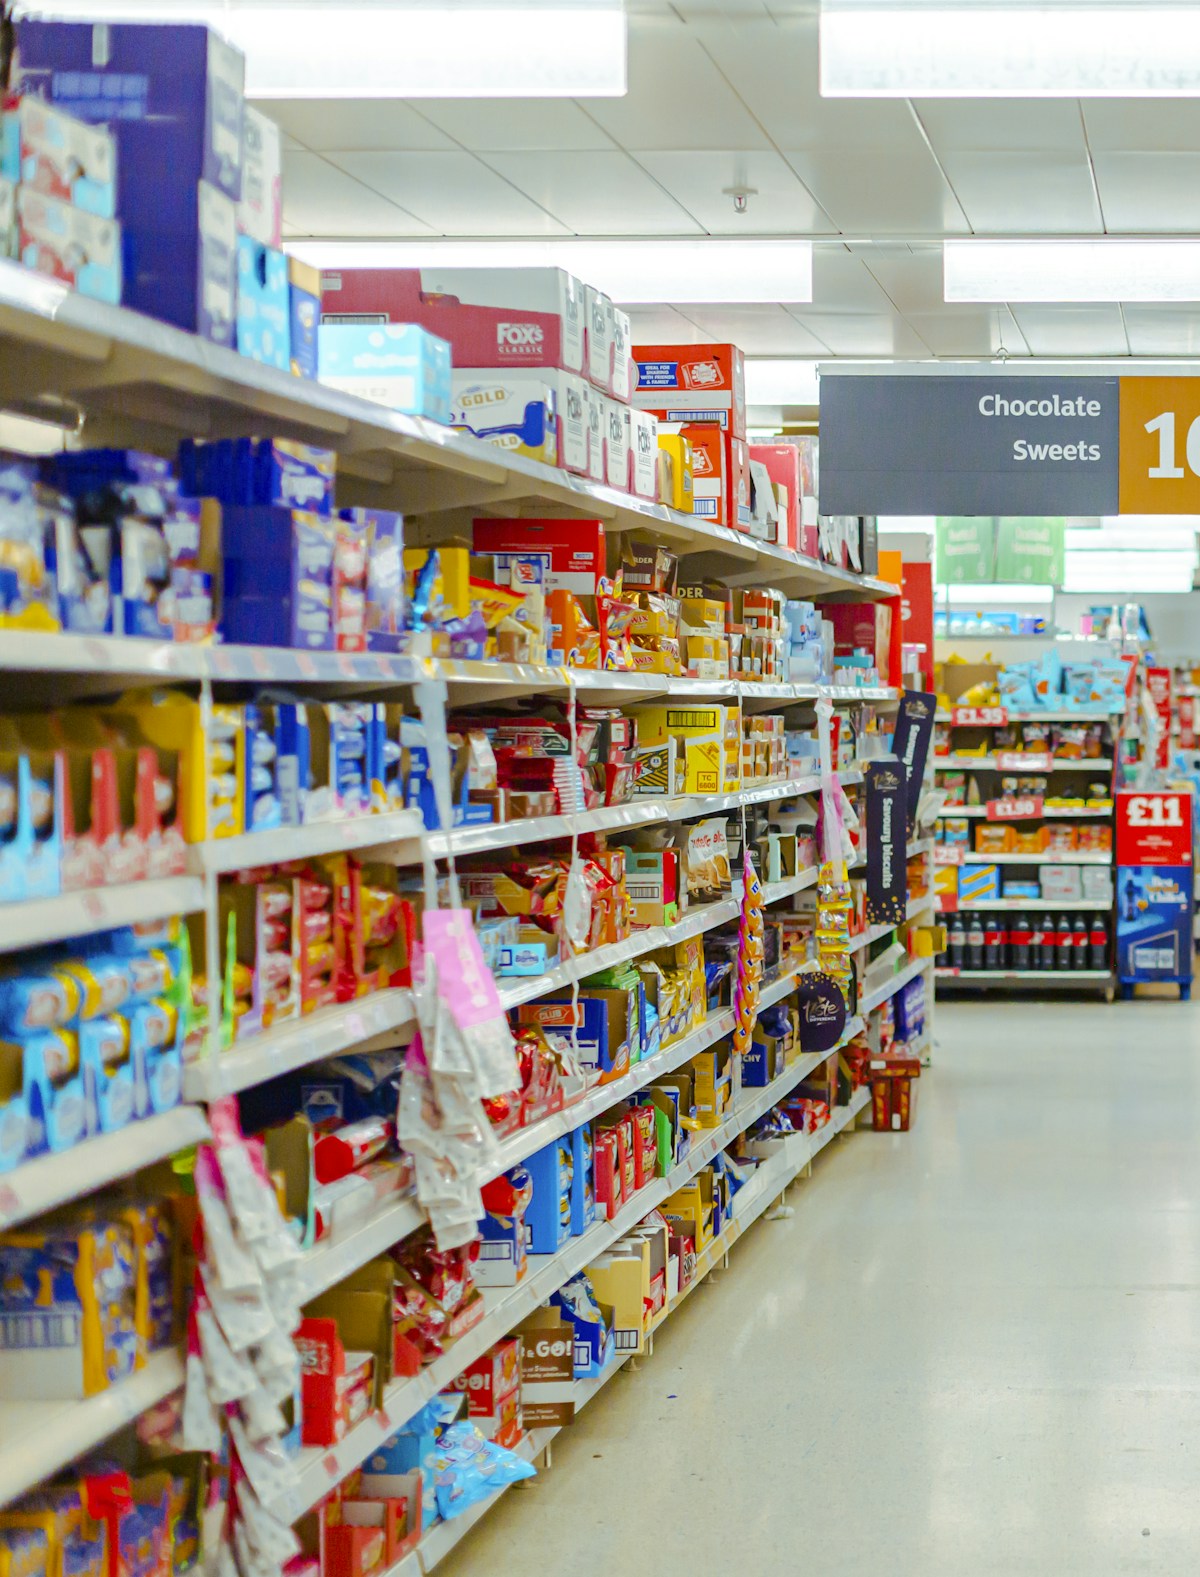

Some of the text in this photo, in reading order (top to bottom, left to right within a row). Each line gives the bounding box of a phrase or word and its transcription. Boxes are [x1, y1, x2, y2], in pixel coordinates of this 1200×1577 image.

[461, 389, 505, 407] GOLD
[979, 394, 1101, 417] Chocolate
[1013, 440, 1101, 461] Sweets
[634, 656, 653, 664] WIX
[956, 708, 1003, 725] £1.35
[881, 798, 894, 843] Savoury
[1126, 797, 1183, 827] £11
[882, 844, 894, 889] biscuits
[536, 1340, 572, 1357] GO!
